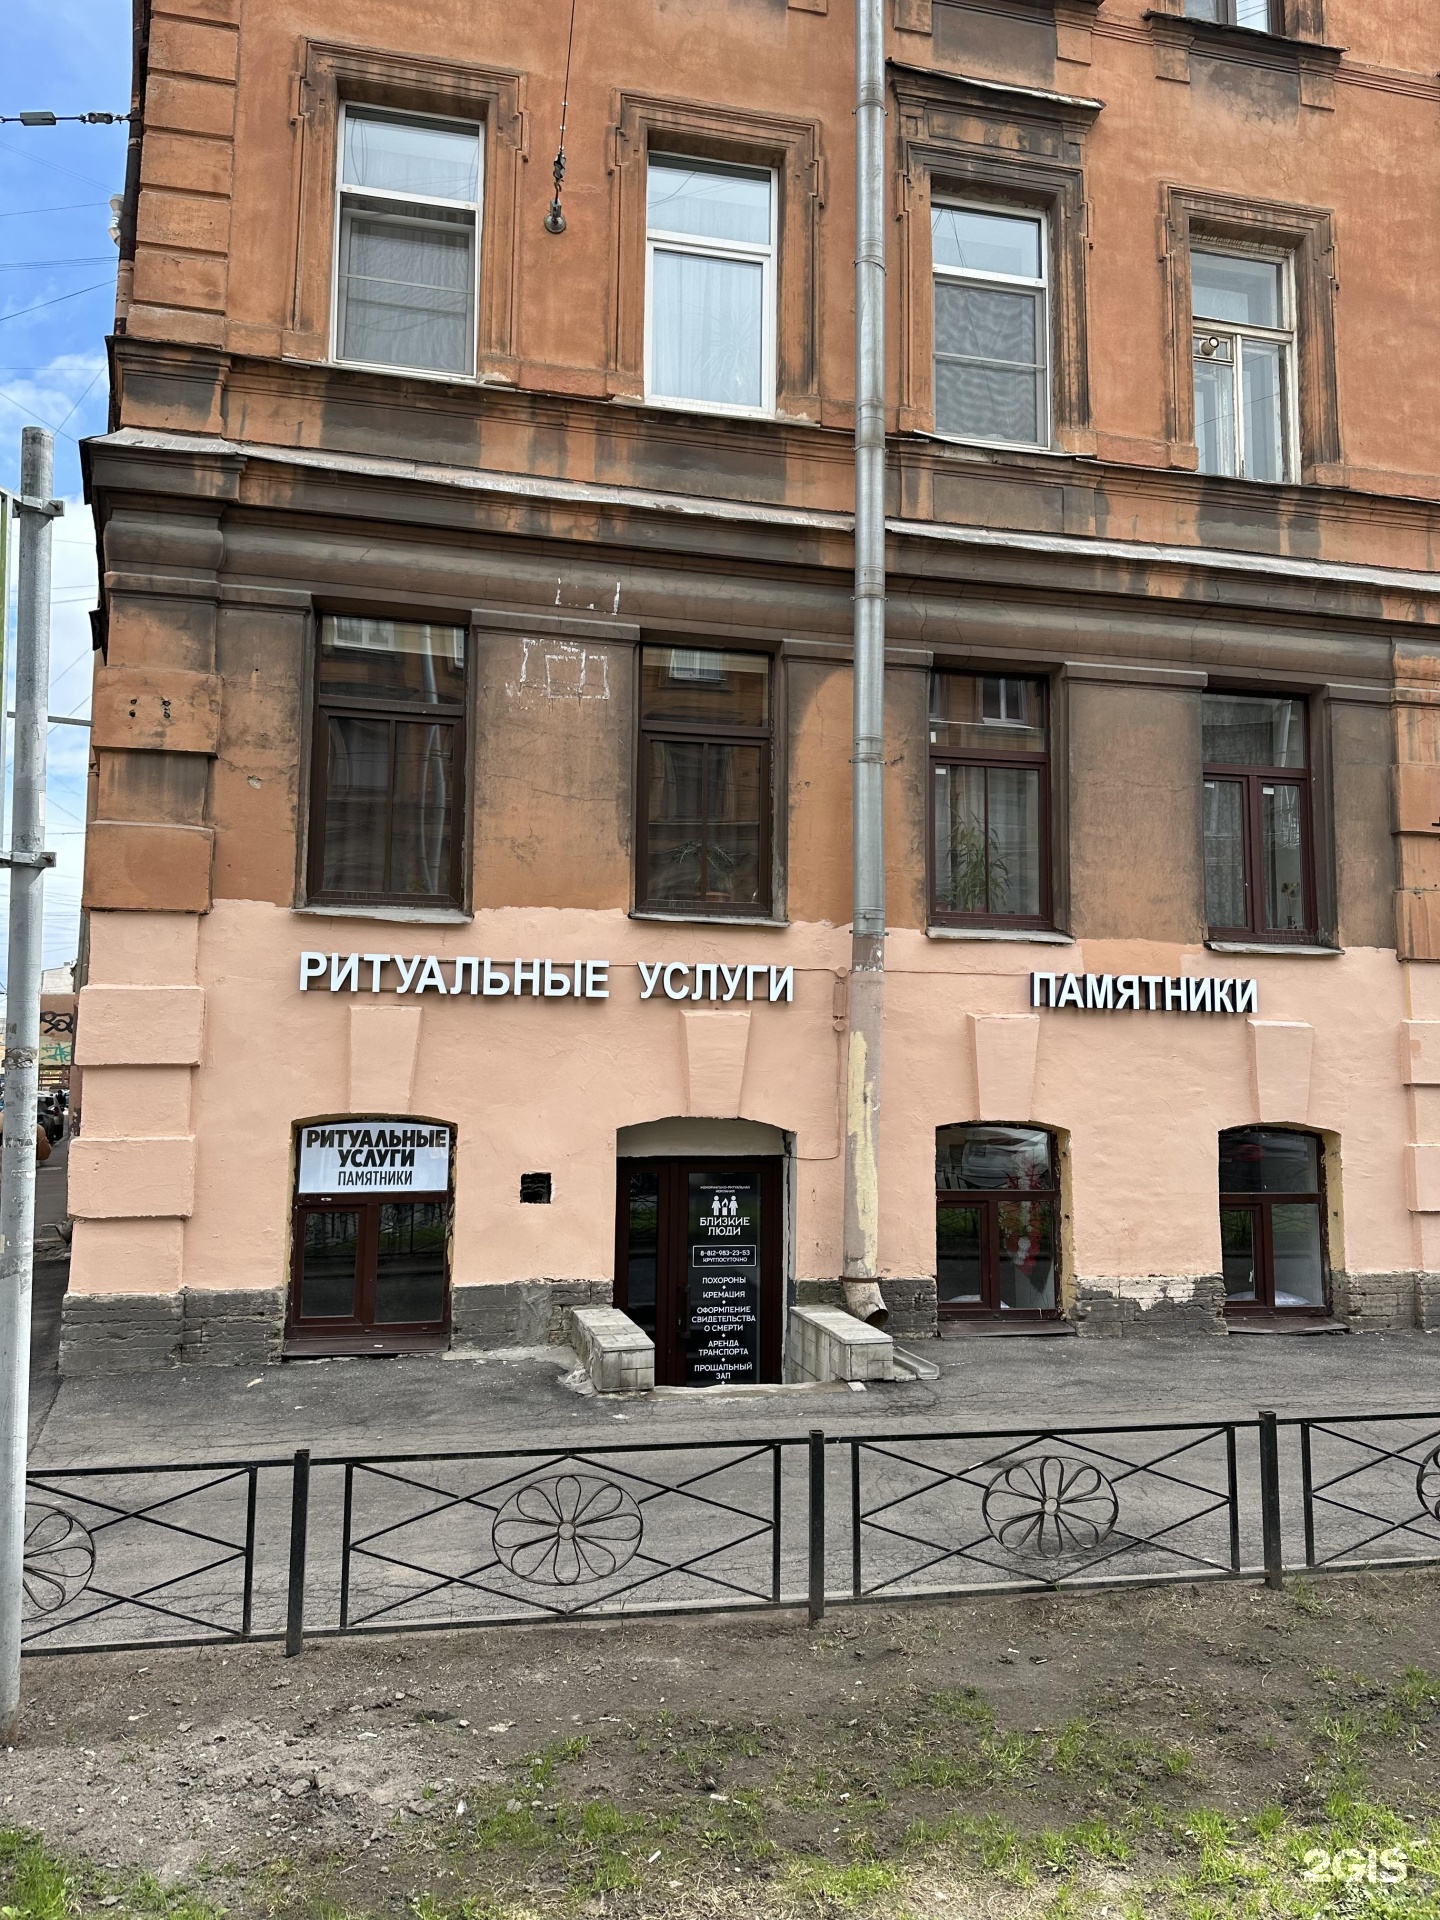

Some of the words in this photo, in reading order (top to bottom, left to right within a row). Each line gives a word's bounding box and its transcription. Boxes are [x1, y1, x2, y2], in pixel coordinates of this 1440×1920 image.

[299, 951, 610, 998] РИТУАЛЬНЫЕ
[637, 961, 795, 1002] УСЛУГИ
[1030, 971, 1257, 1013] ПАМЯТНИКИ
[306, 1129, 447, 1148] РИТУАЛЬНЫЕ
[339, 1149, 415, 1168] УСЛУГИ
[337, 1170, 413, 1186] ПАМЯТНИКИ
[699, 1216, 750, 1226] БЛИЗКИЕ
[708, 1226, 741, 1236] ЛЮДИ
[702, 1276, 747, 1284] ПОХОРОНЫ
[702, 1291, 746, 1299] КРЕМАЦИЯ
[697, 1306, 751, 1314] ОФОРМЛЕНИЕ
[691, 1315, 757, 1323] СВИДЕТЕЛЬСТВА
[711, 1324, 744, 1332] СМЕРТИ
[708, 1340, 740, 1348] АРЕНДА
[698, 1348, 749, 1357] ТРАНСПОРТА
[694, 1361, 753, 1372] ПРОЩАЛЬНЫЙ
[715, 1372, 731, 1380] ЗАЛ
